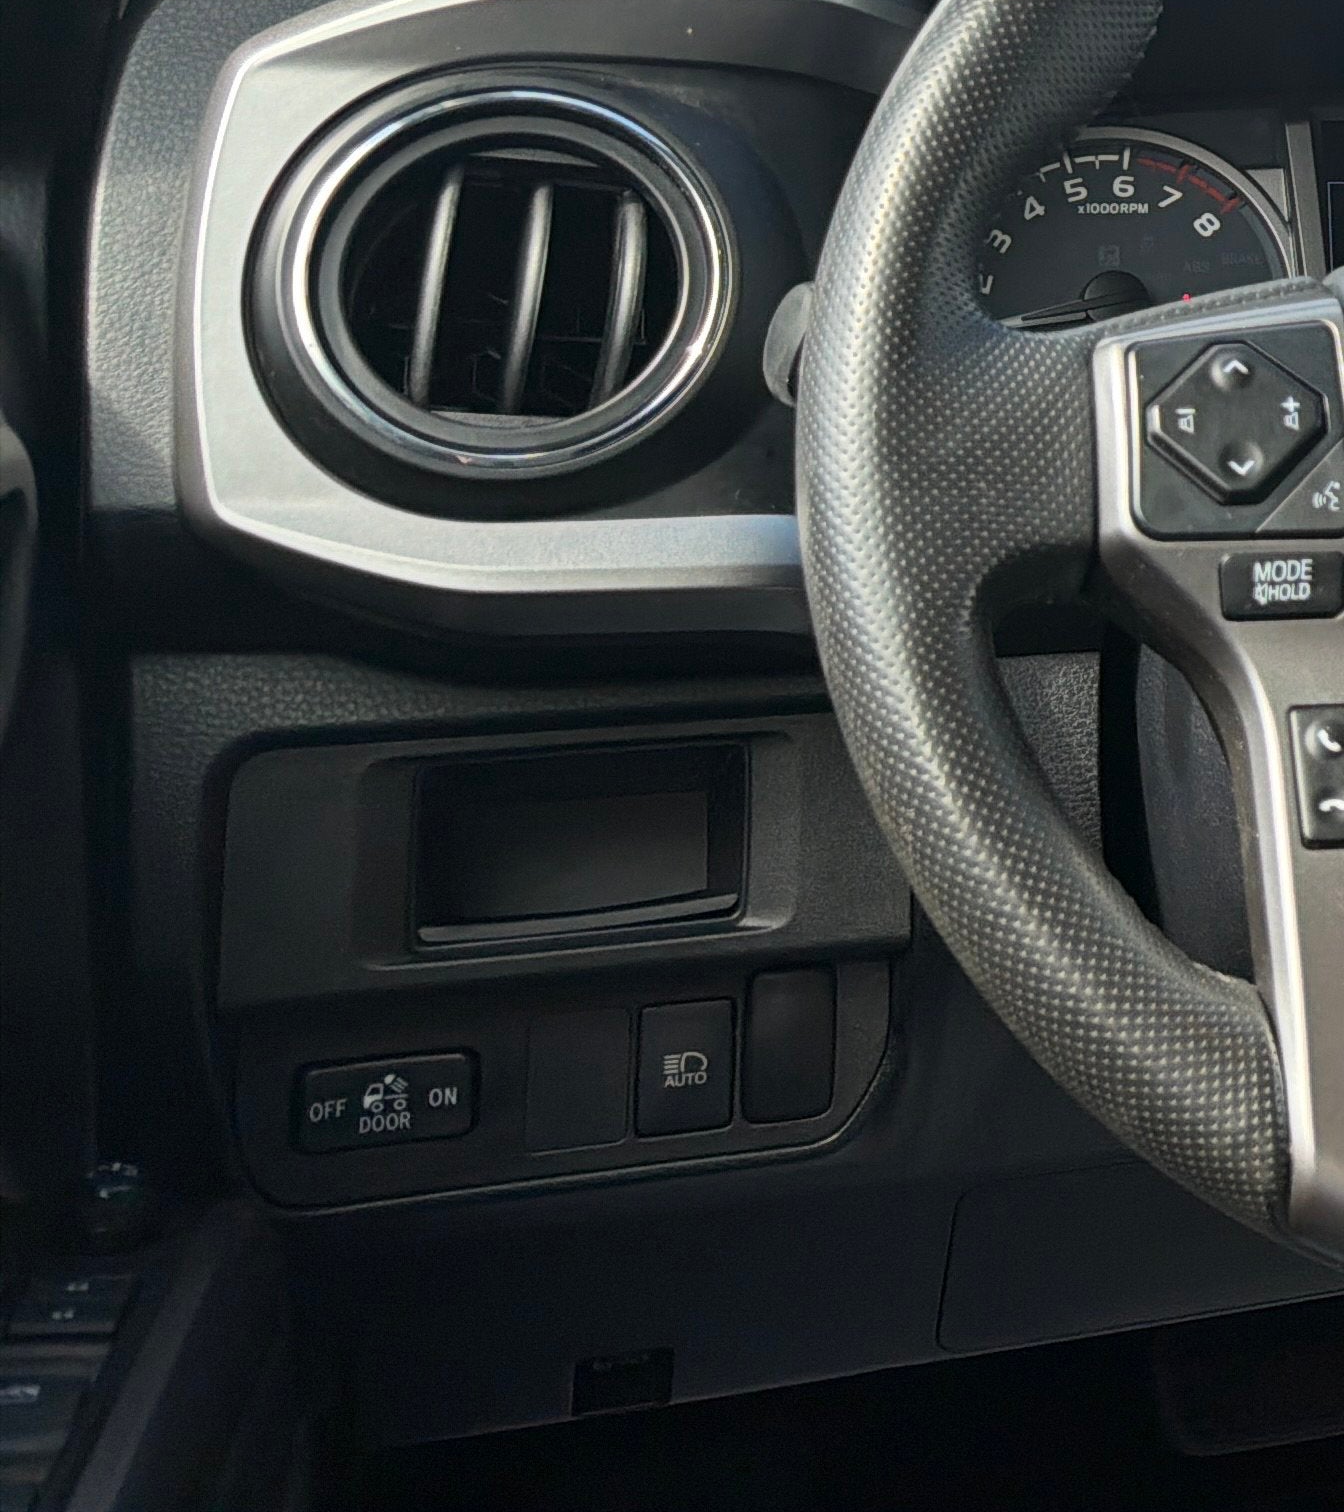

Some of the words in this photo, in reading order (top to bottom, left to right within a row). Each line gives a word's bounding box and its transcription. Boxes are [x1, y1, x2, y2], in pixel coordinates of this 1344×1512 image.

[1063, 177, 1088, 203] 5
[1112, 175, 1136, 198] 6
[1158, 185, 1184, 209] 7
[1023, 196, 1046, 221] 4
[1192, 212, 1221, 238] 8
[984, 228, 1013, 254] 3
[1253, 559, 1313, 583] MODE
[1268, 582, 1312, 601] HOLD
[664, 1069, 707, 1087] AUTO
[428, 1087, 458, 1108] ON
[309, 1099, 347, 1122] OFF
[358, 1112, 411, 1135] DOOR
